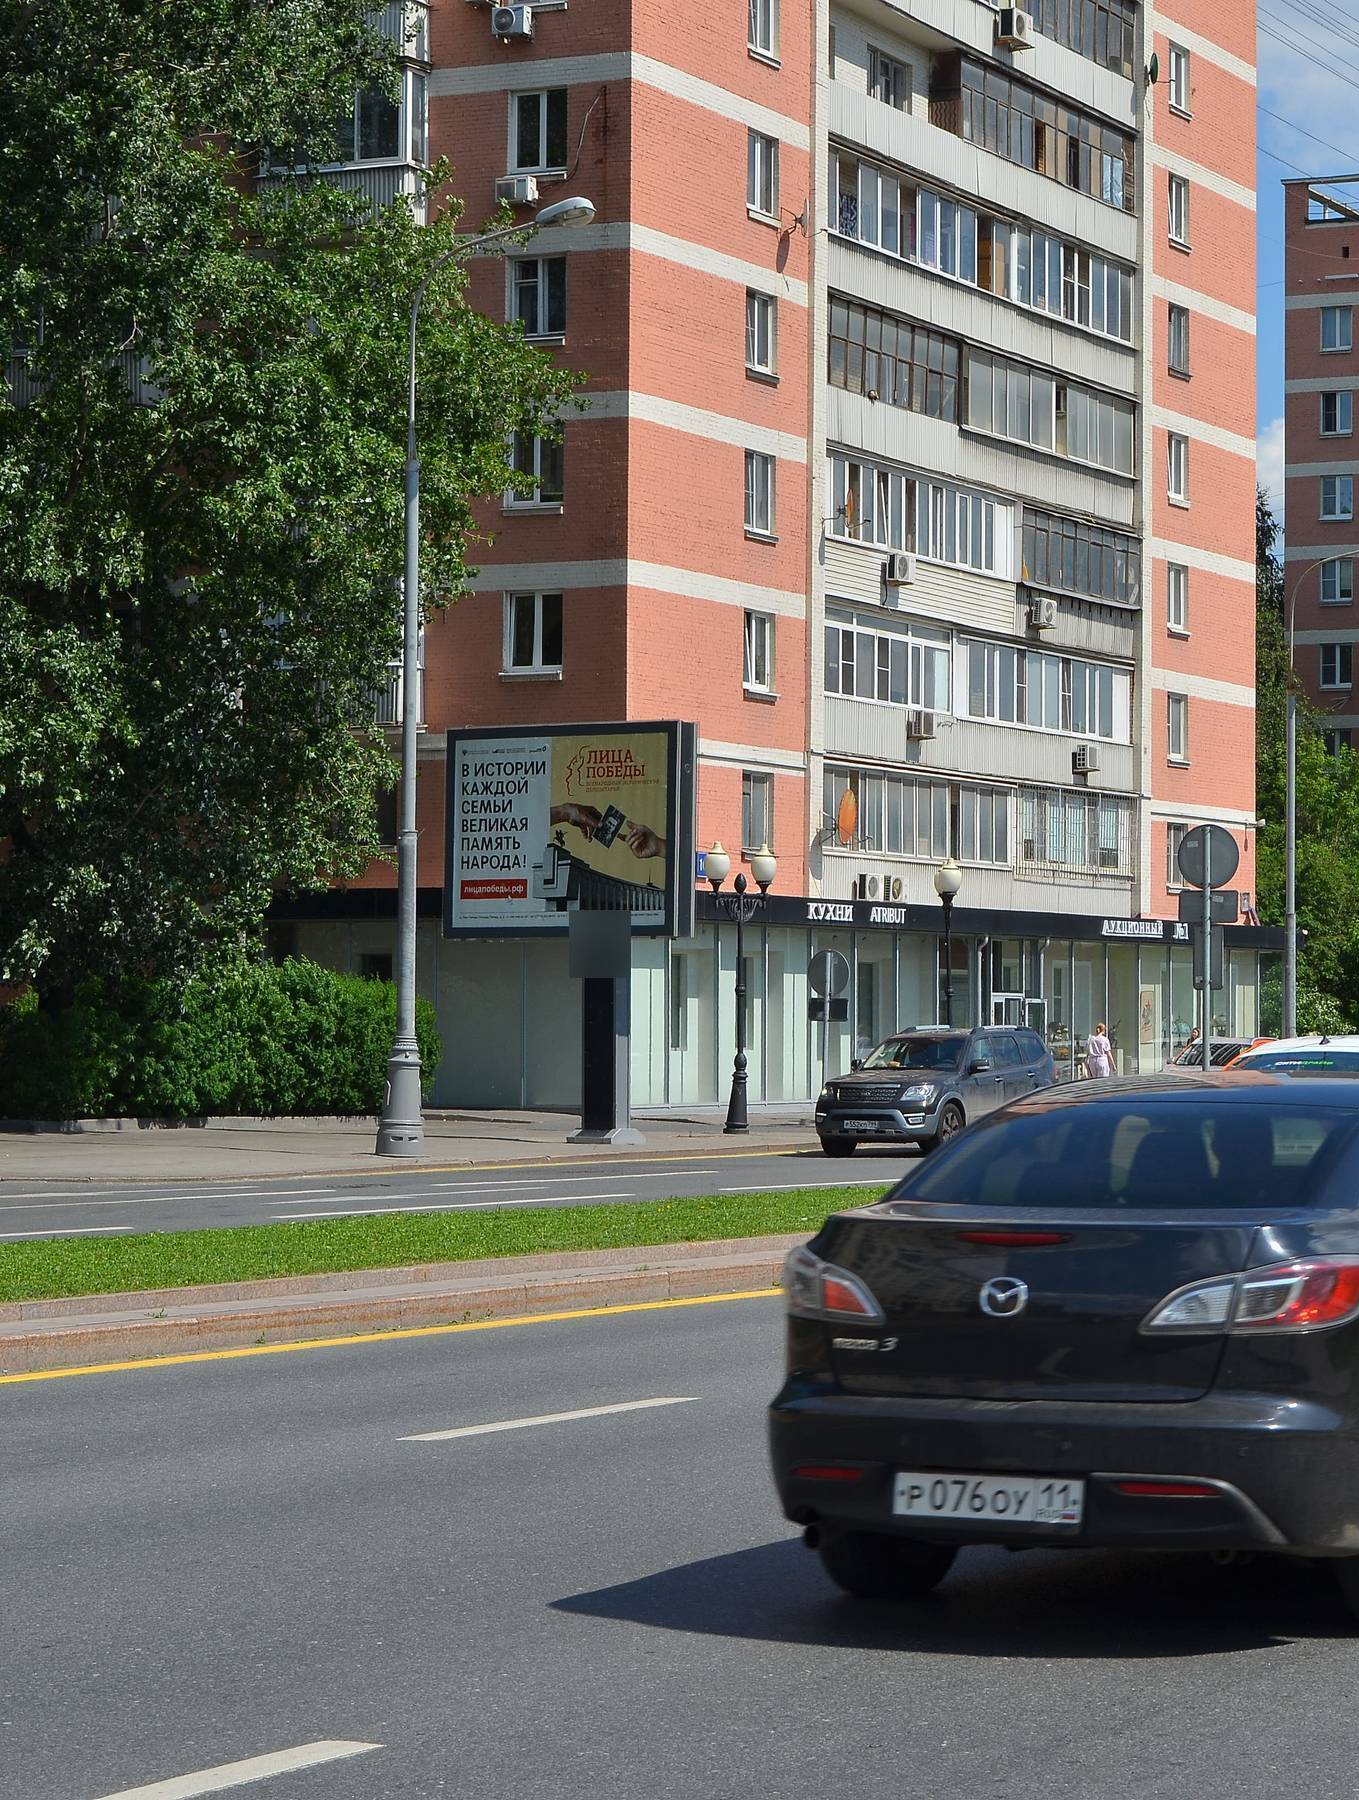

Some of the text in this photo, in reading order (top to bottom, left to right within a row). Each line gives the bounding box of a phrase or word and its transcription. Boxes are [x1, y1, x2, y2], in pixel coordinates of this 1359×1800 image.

[586, 749, 634, 768] ЛИЦА
[461, 760, 546, 778] В ИСТОРИИ
[586, 764, 646, 780] ПОБЕДЫ
[461, 776, 529, 797] КАЖДОЙ
[461, 799, 513, 815] СЕМЬИ
[461, 817, 529, 833] ВЕЛИКАЯ
[461, 836, 521, 851] ПАМЯТЬ
[461, 854, 527, 871] НАРОДА!
[463, 885, 524, 896] лицапобеды.рф
[806, 902, 854, 922] КУХНИ
[870, 906, 907, 924] ATRIBUT
[1102, 920, 1163, 937] АУКЦИОННЫЙ
[879, 1337, 899, 1352] 3
[1040, 1483, 1072, 1508] 11
